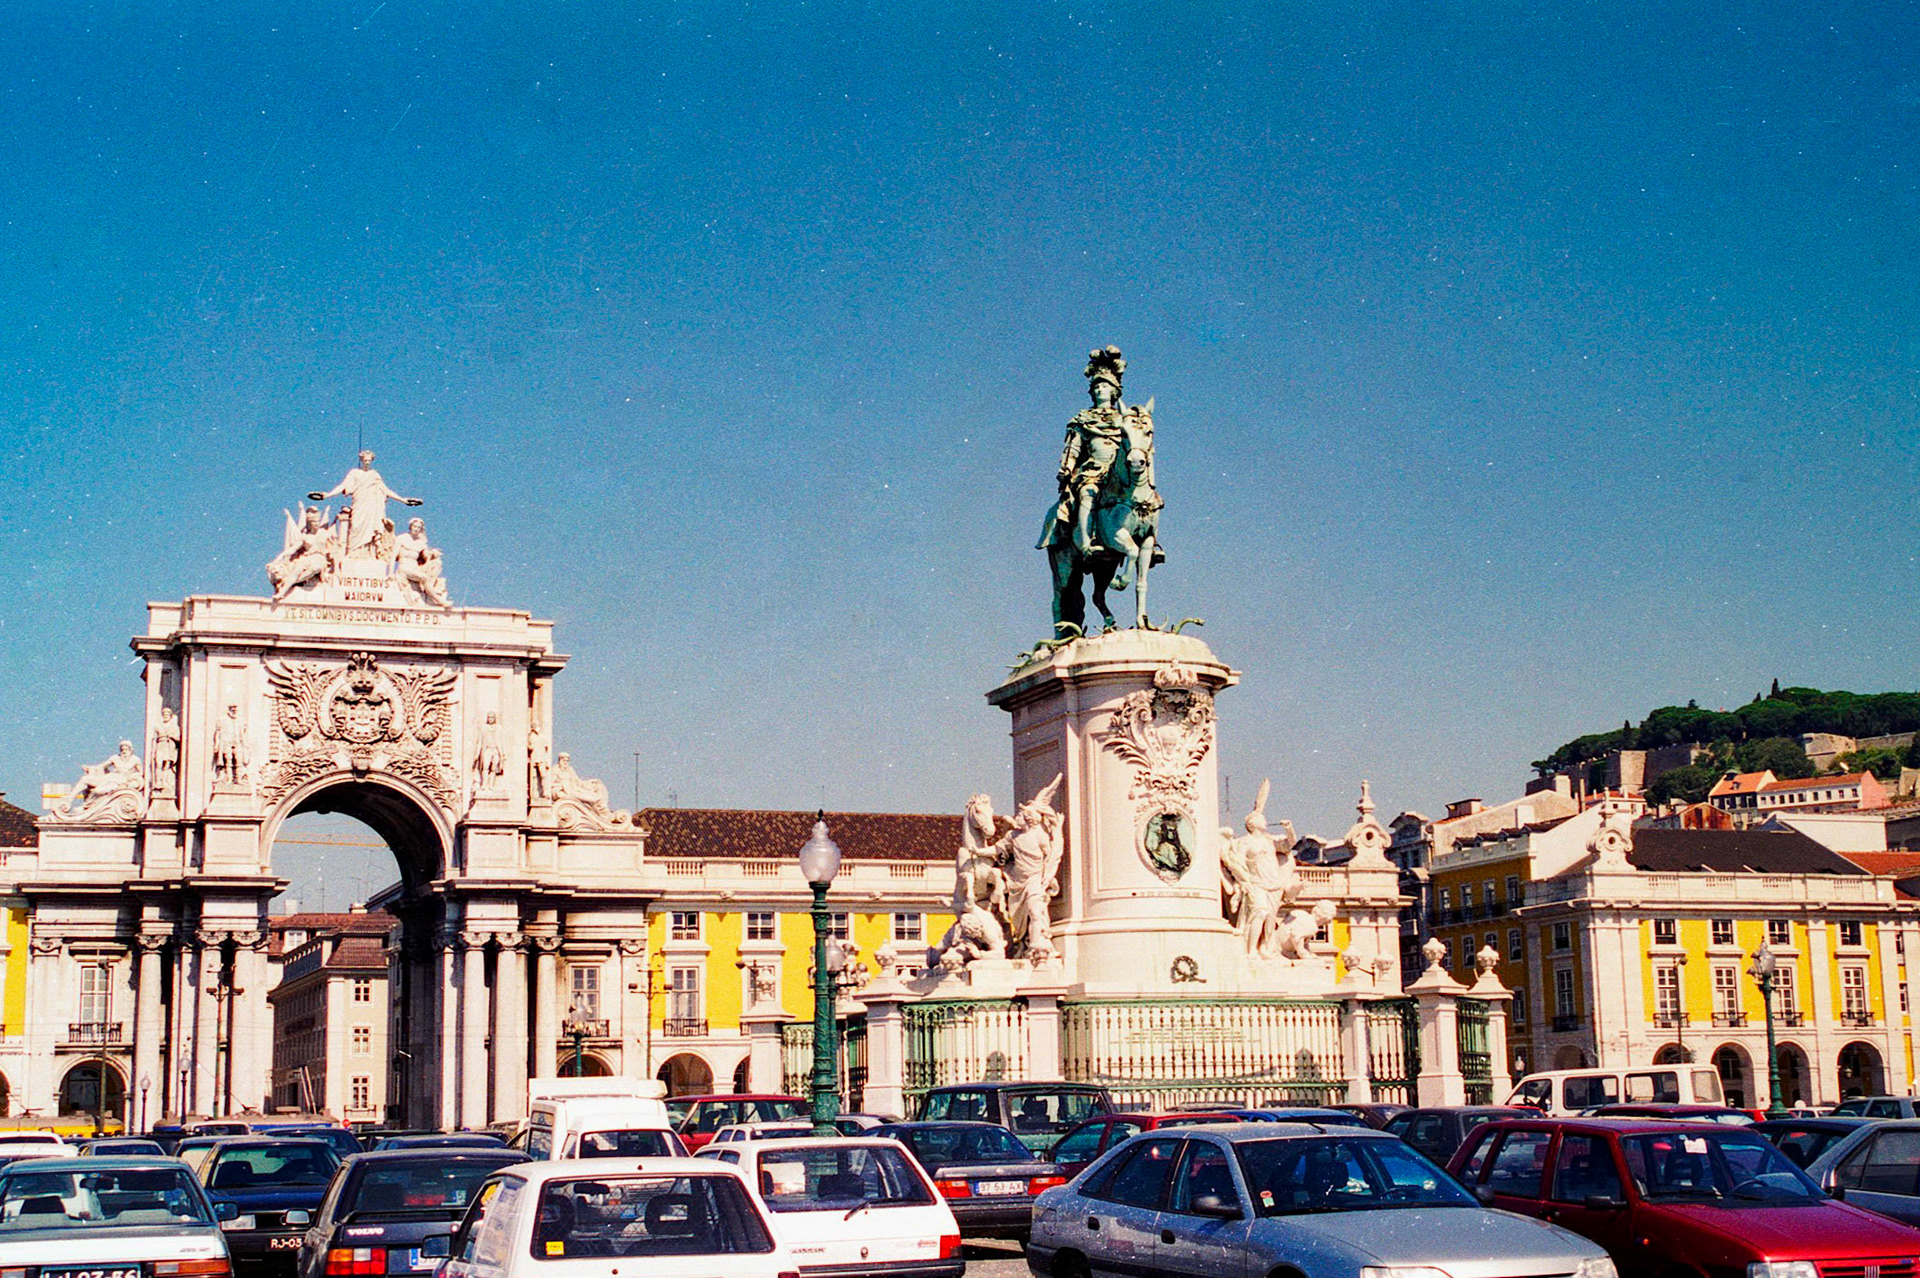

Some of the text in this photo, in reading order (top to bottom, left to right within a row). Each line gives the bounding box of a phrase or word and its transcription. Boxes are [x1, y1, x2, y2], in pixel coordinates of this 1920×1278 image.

[338, 576, 390, 589] VIRTVTIBVS
[345, 591, 383, 602] MAIORVM
[347, 1227, 385, 1236] VOLVO
